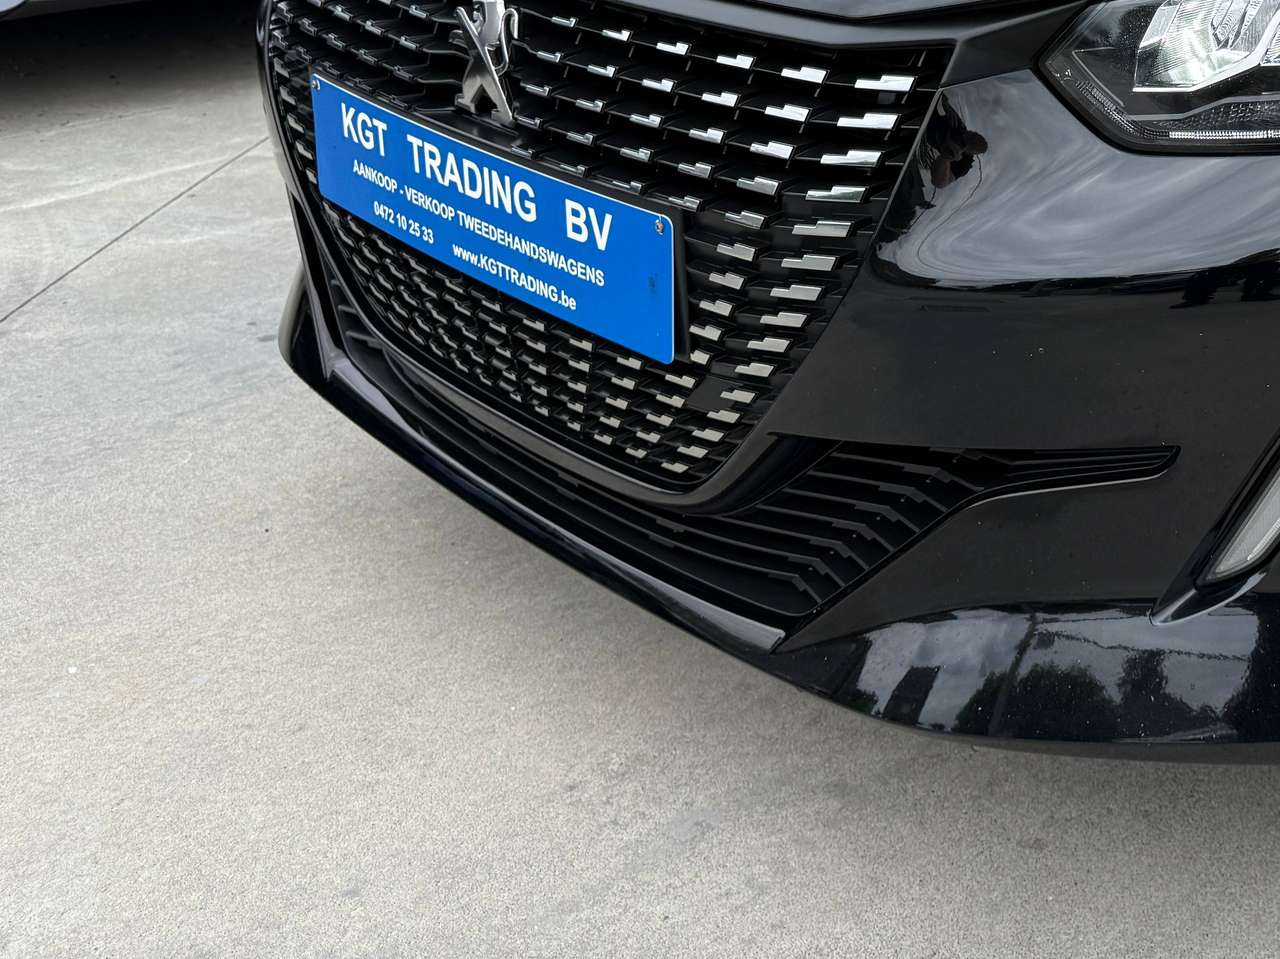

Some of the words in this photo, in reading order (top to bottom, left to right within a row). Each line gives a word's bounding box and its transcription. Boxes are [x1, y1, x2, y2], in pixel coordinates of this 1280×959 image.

[340, 102, 388, 157] KGT
[406, 134, 537, 223] TRADING
[564, 198, 613, 251] BV
[353, 159, 398, 193] AANKOOP
[404, 185, 455, 221] VERKOOP
[457, 210, 605, 287] TWEEDEHANDSWAGENS
[373, 201, 395, 224] 0472
[396, 213, 408, 230] 10
[408, 219, 421, 238] 25
[421, 226, 434, 244] 33
[452, 244, 577, 311] www.KGTTRADING.be
